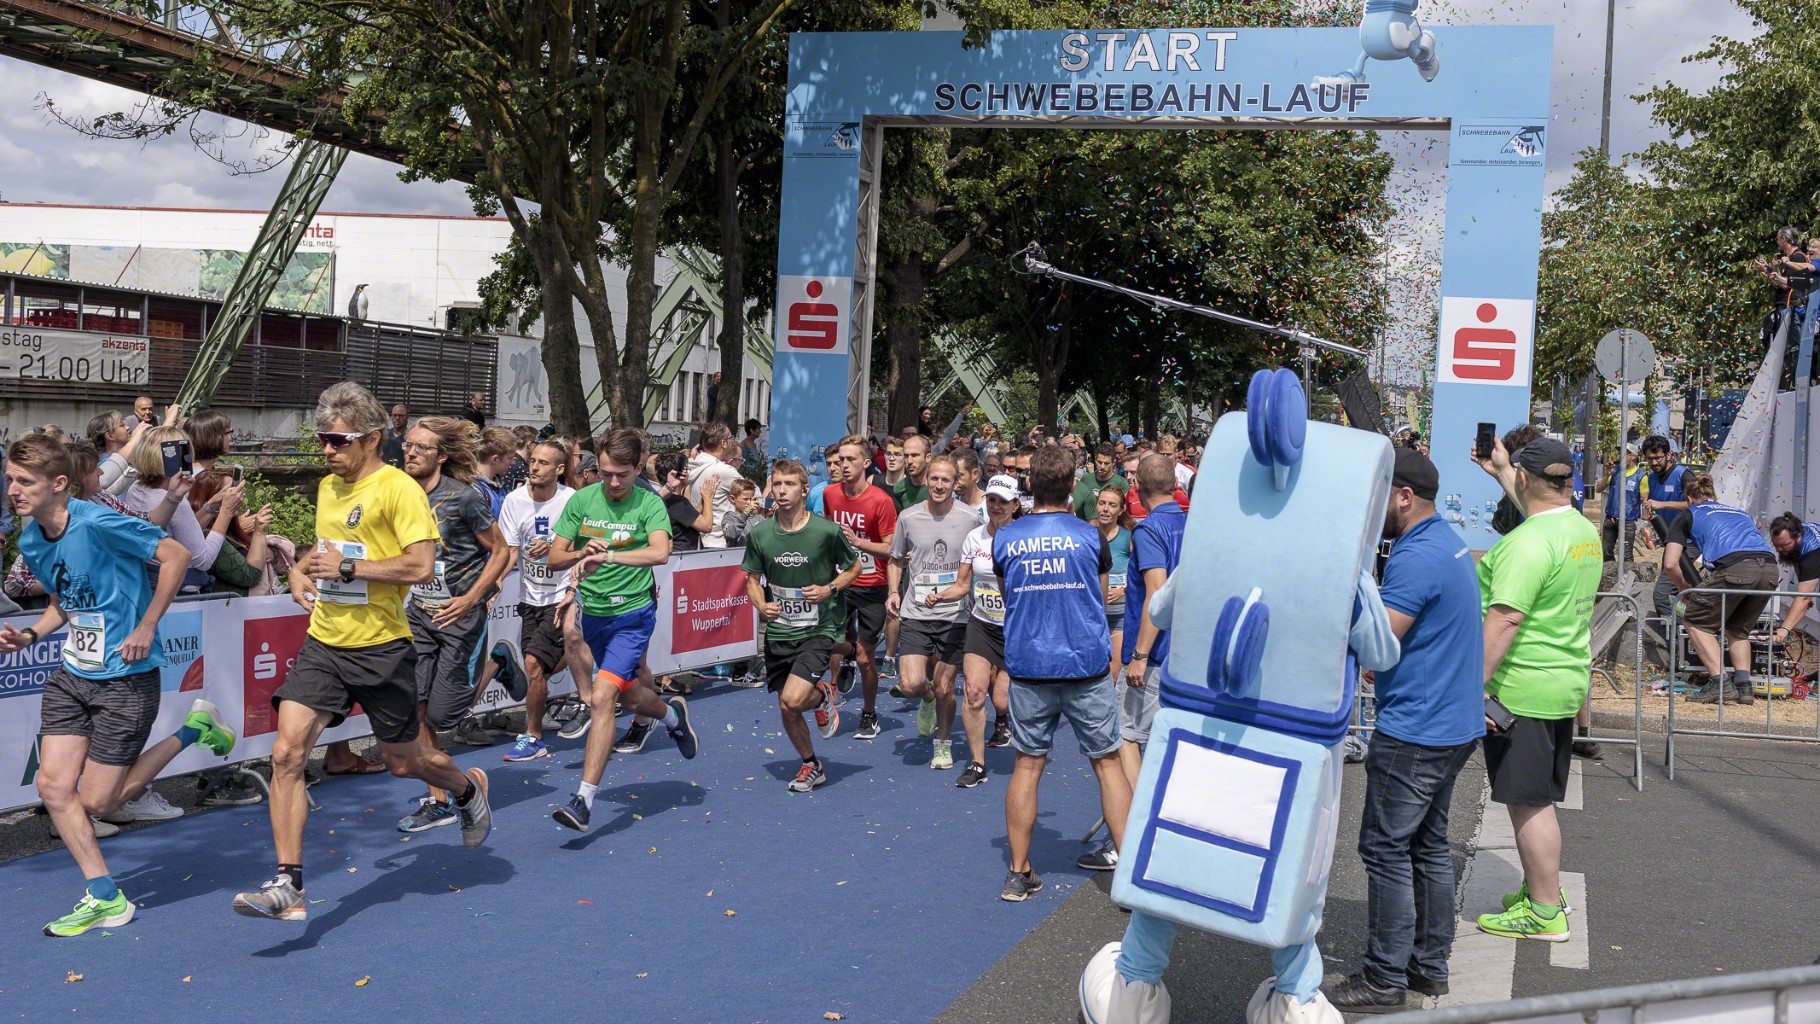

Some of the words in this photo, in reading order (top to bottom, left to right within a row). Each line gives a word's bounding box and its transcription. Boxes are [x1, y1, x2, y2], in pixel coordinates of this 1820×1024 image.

[1059, 32, 1238, 72] START
[933, 82, 1371, 113] SCHWEBEBAHN-LAUF
[101, 336, 147, 352] akzenta
[20, 353, 90, 381] 21.00
[101, 359, 145, 384] Uhr
[582, 517, 638, 531] LaufCampus
[833, 510, 866, 529] LIVE
[1007, 536, 1080, 558] KAMERA-
[1021, 557, 1066, 576] TEAM
[1012, 581, 1086, 593] www.schwebebahn-lauf.de
[692, 594, 748, 612] Stadtsparkasse
[692, 612, 731, 632] Wuppertal
[75, 631, 97, 652] 82
[163, 636, 199, 653] ANER
[477, 689, 508, 704] KERN
